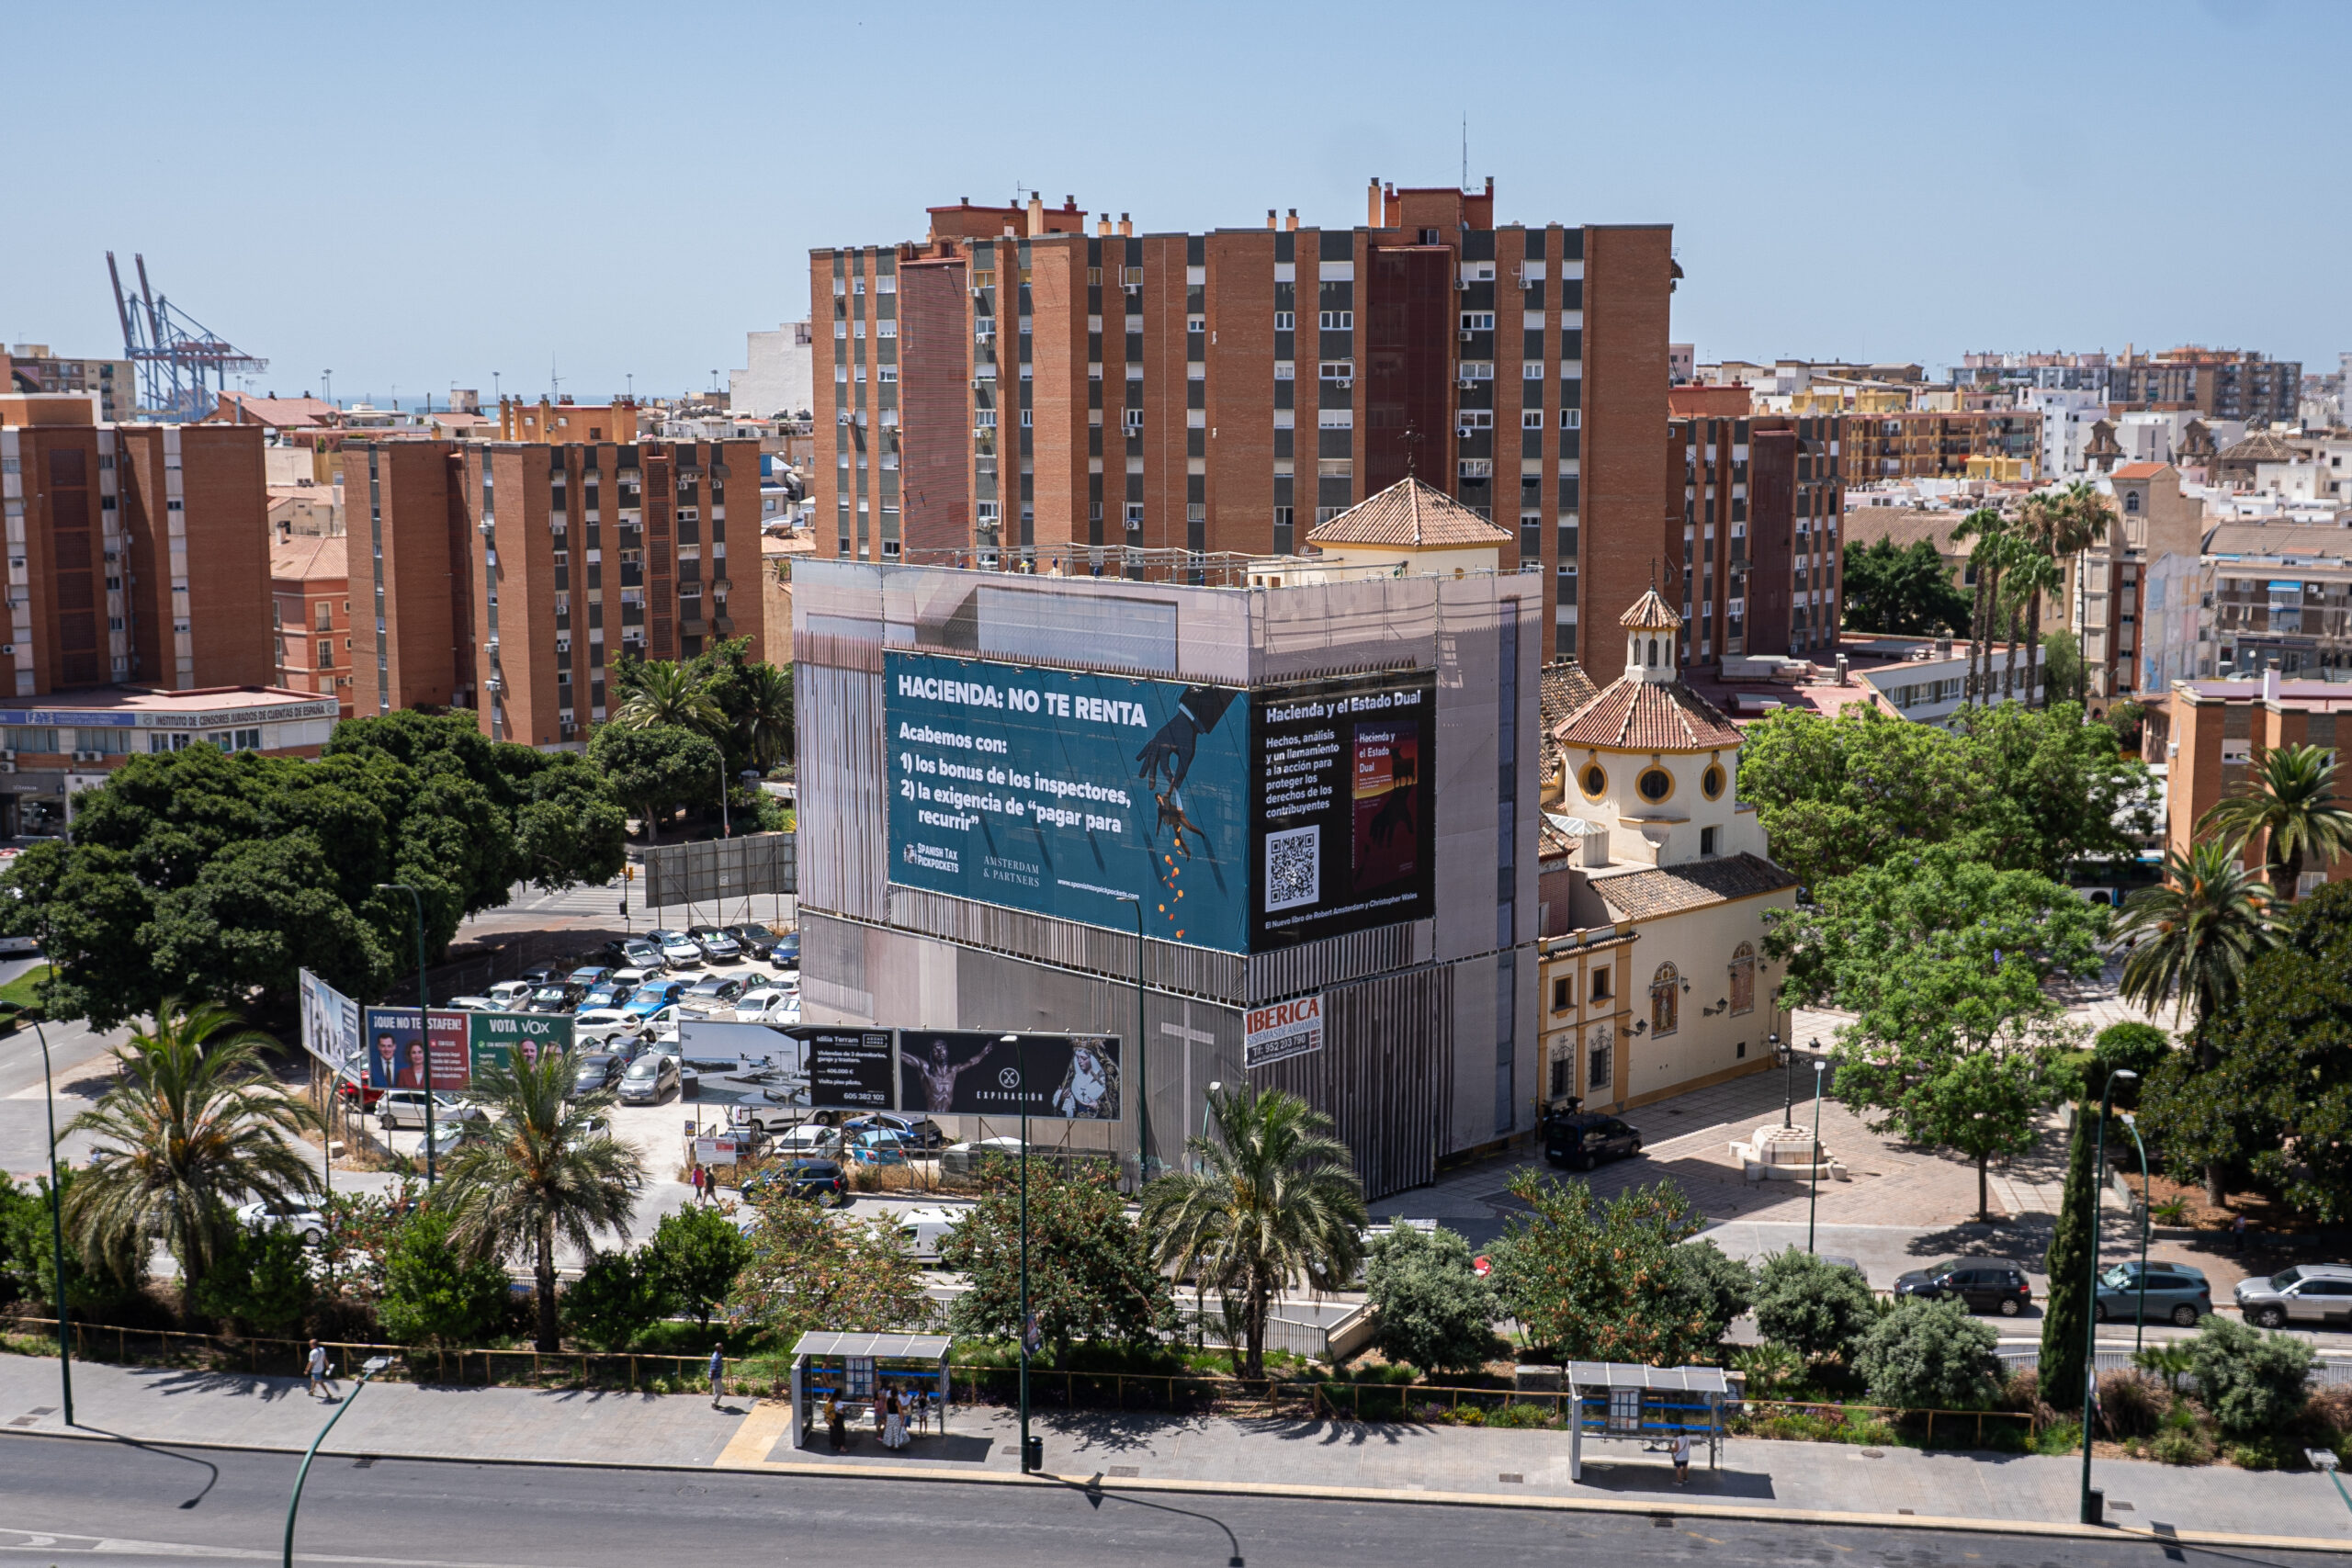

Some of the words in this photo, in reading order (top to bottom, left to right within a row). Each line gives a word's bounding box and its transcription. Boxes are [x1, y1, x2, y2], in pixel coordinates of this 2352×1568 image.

[899, 674, 1003, 708] HACIENDA:
[1008, 687, 1039, 713] NO
[1045, 692, 1069, 717] TE
[1076, 695, 1148, 728] RENTA
[1266, 702, 1324, 723] Hacienda
[1327, 704, 1335, 718] y
[1337, 698, 1348, 714] el
[1351, 694, 1391, 712] Estado
[1394, 689, 1421, 706] Dual
[155, 715, 187, 727] INSTITUTO
[188, 716, 197, 726] DE
[199, 714, 229, 726] CENSORES
[231, 711, 258, 723] JURADOS
[258, 710, 266, 720] DE
[267, 708, 293, 719] CUENTAS
[294, 707, 302, 717] DE
[303, 704, 325, 716] ESPAÑA
[899, 721, 972, 750] Acabemos
[975, 737, 1007, 754] con:
[1266, 736, 1301, 749] Hechos,
[1303, 728, 1335, 743] análisis
[1359, 732, 1389, 744] Hacienda
[1390, 733, 1396, 743] y
[1266, 753, 1272, 764] y
[1273, 752, 1285, 761] un
[1286, 743, 1340, 760] llamamiento
[1359, 750, 1366, 758] el
[1367, 746, 1389, 758] Estado
[1266, 768, 1272, 776] a
[1273, 765, 1282, 775] la
[1283, 760, 1311, 773] acción
[1313, 759, 1332, 772] para
[1359, 761, 1374, 773] Dual
[899, 752, 912, 774] 1)
[915, 754, 936, 774] los
[939, 758, 983, 782] bonus
[987, 766, 1005, 785] de
[1009, 768, 1031, 789] los
[1035, 771, 1131, 808] inspectores,
[1266, 776, 1304, 793] proteger
[1305, 773, 1317, 784] los
[1266, 790, 1306, 805] derechos
[1306, 786, 1318, 797] de
[1319, 784, 1332, 795] los
[900, 779, 915, 802] 2)
[918, 782, 931, 801] la
[933, 785, 1002, 813] exigencia
[1005, 796, 1024, 816] de
[1085, 811, 1122, 833] para
[1266, 800, 1329, 818] contribuyentes
[918, 842, 944, 858] SPANISH
[944, 847, 957, 861] TAX
[917, 855, 959, 873] PICKPOCKETS
[983, 855, 1039, 875] AMSTERDAM
[983, 867, 989, 878] &
[993, 869, 1040, 888] PARTNERS
[1057, 878, 1139, 900] www.spanishtaxpickpockets.com
[1265, 921, 1272, 931] El
[1272, 918, 1291, 929] Nuevo
[1292, 915, 1305, 925] libro
[1306, 913, 1313, 921] de
[1314, 909, 1332, 919] Robert
[1333, 902, 1364, 916] Amsterdam
[1364, 902, 1370, 910] y
[1369, 895, 1401, 908] Christopher
[1401, 892, 1418, 901] Wales
[396, 1017, 410, 1029] NO
[411, 1017, 421, 1029] TE
[426, 1017, 462, 1031] STAFEN!
[489, 1019, 517, 1032] VOTA
[521, 1020, 550, 1034] VOX
[1246, 998, 1320, 1035] IBERICA
[1247, 1028, 1278, 1045] SISTEMAS
[1279, 1027, 1286, 1038] DE
[1287, 1018, 1320, 1035] ANDAMIOS
[1264, 1041, 1279, 1054] 952
[1294, 1034, 1306, 1045] 790
